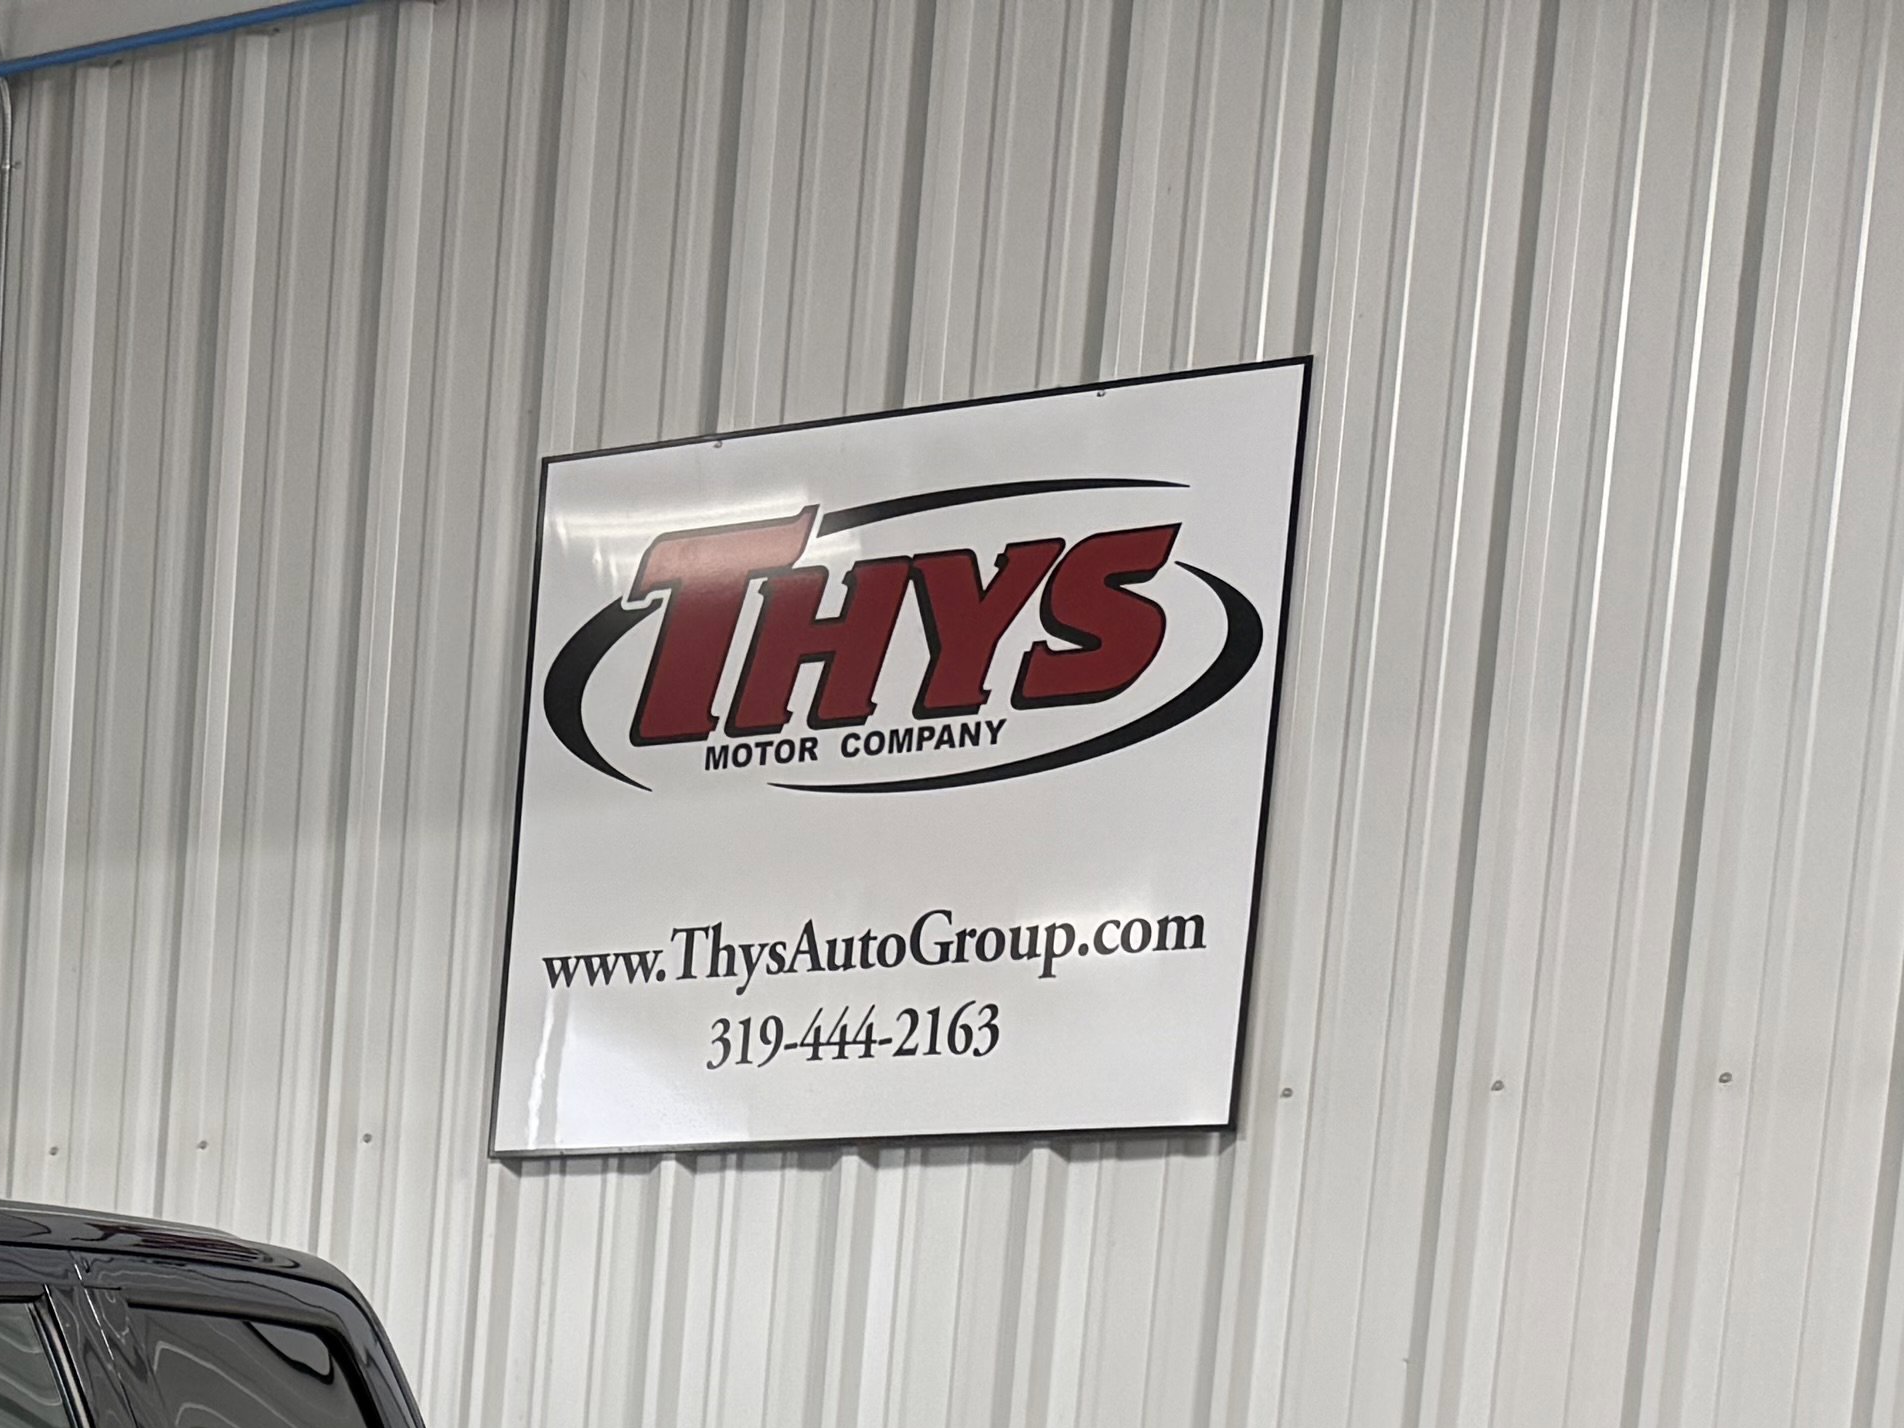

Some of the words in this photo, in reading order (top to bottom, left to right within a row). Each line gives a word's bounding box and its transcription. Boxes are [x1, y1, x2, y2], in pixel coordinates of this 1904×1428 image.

[624, 503, 1182, 748] THYS
[703, 735, 819, 772] MOTOR
[839, 717, 1008, 759] COMPANY
[542, 908, 1208, 996] www.ThysAutoGroup.com
[705, 1000, 1002, 1070] 319-444-2163
